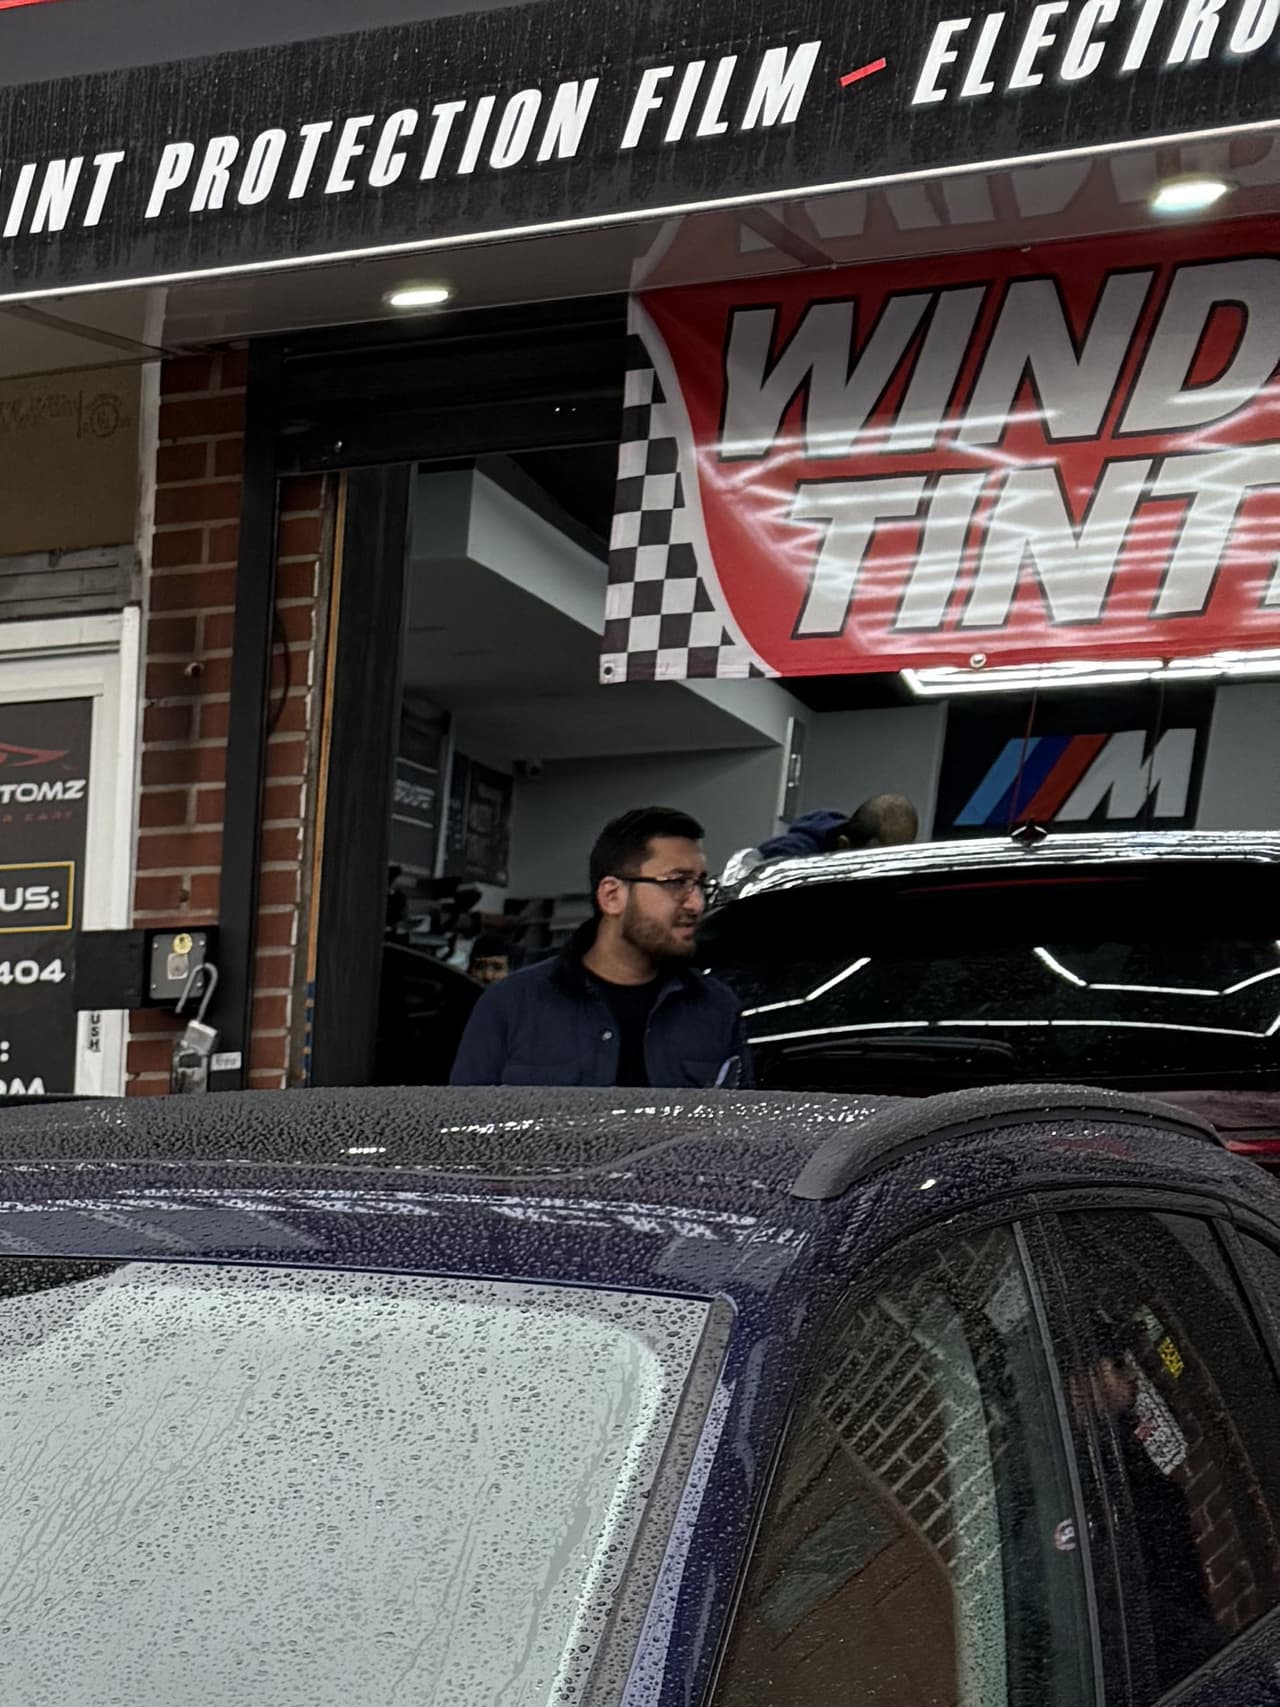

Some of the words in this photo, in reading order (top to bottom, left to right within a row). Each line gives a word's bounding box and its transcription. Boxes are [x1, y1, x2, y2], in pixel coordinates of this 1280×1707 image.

[146, 79, 596, 222] PROTECTION
[618, 42, 822, 150] FILM
[723, 255, 1280, 460] WIND
